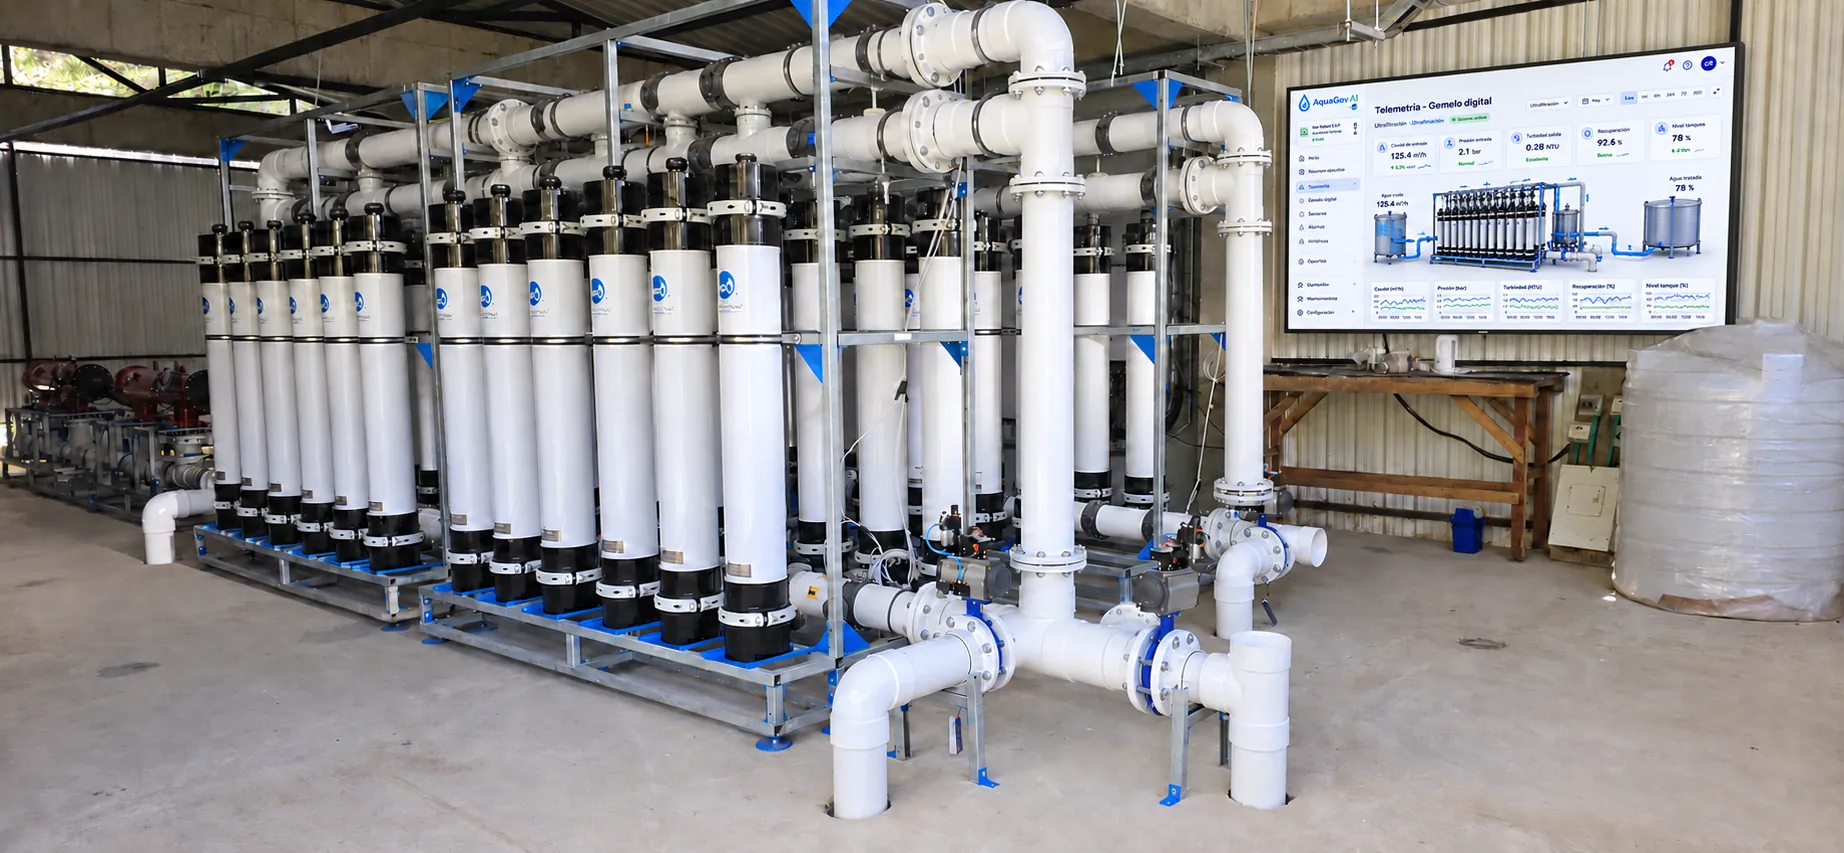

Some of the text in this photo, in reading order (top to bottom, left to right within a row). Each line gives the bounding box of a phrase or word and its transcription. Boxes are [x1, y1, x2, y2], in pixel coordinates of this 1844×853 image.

[1313, 94, 1358, 107] AquaGov AI
[1428, 100, 1462, 110] Gemelo
[1464, 97, 1492, 108] digital
[1672, 134, 1683, 142] 78
[1526, 143, 1544, 151] 0.28
